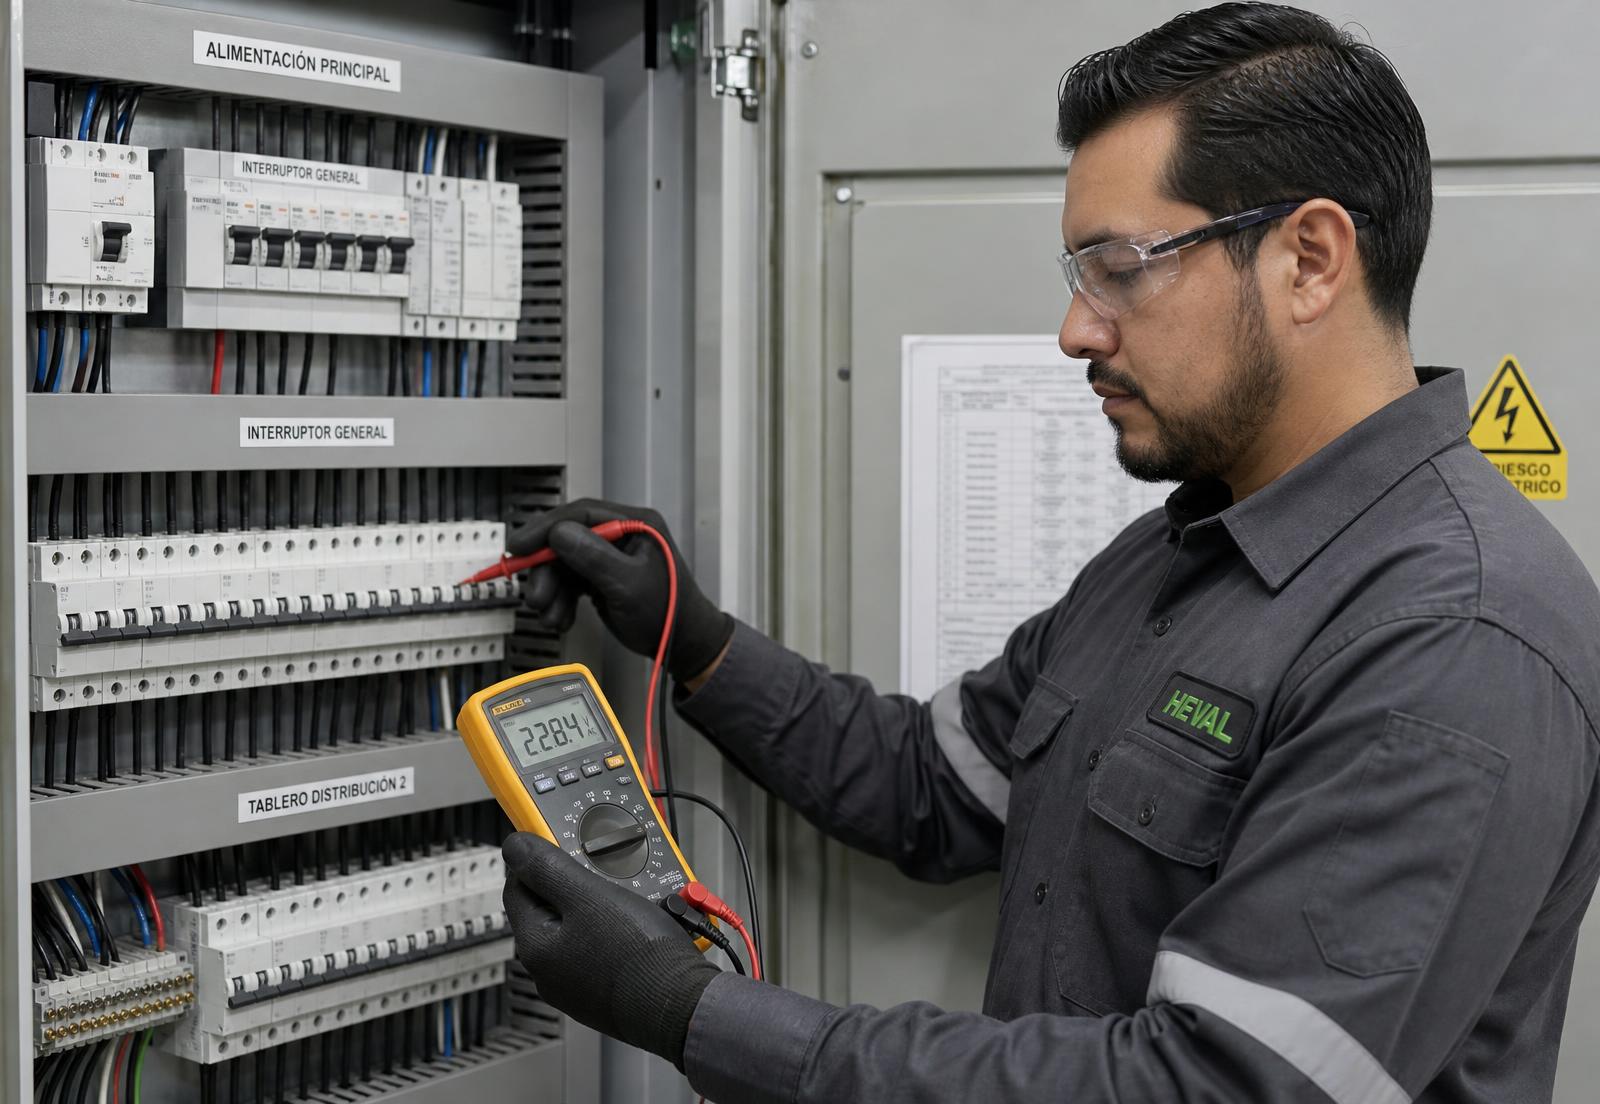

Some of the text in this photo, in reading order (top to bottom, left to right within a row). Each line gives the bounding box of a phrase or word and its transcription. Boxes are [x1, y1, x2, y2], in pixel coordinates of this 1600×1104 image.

[206, 41, 391, 83] ALIMENTACIÓN PRINCIPAL
[242, 160, 361, 185] INTERRUPTOR GENERAL
[247, 425, 387, 440] INTERRUPTOR GENERAL
[1514, 479, 1561, 494] TRICO
[1162, 689, 1233, 745] HEVAL
[248, 775, 407, 814] TABLERO DISTRIBUCIÓN 2
